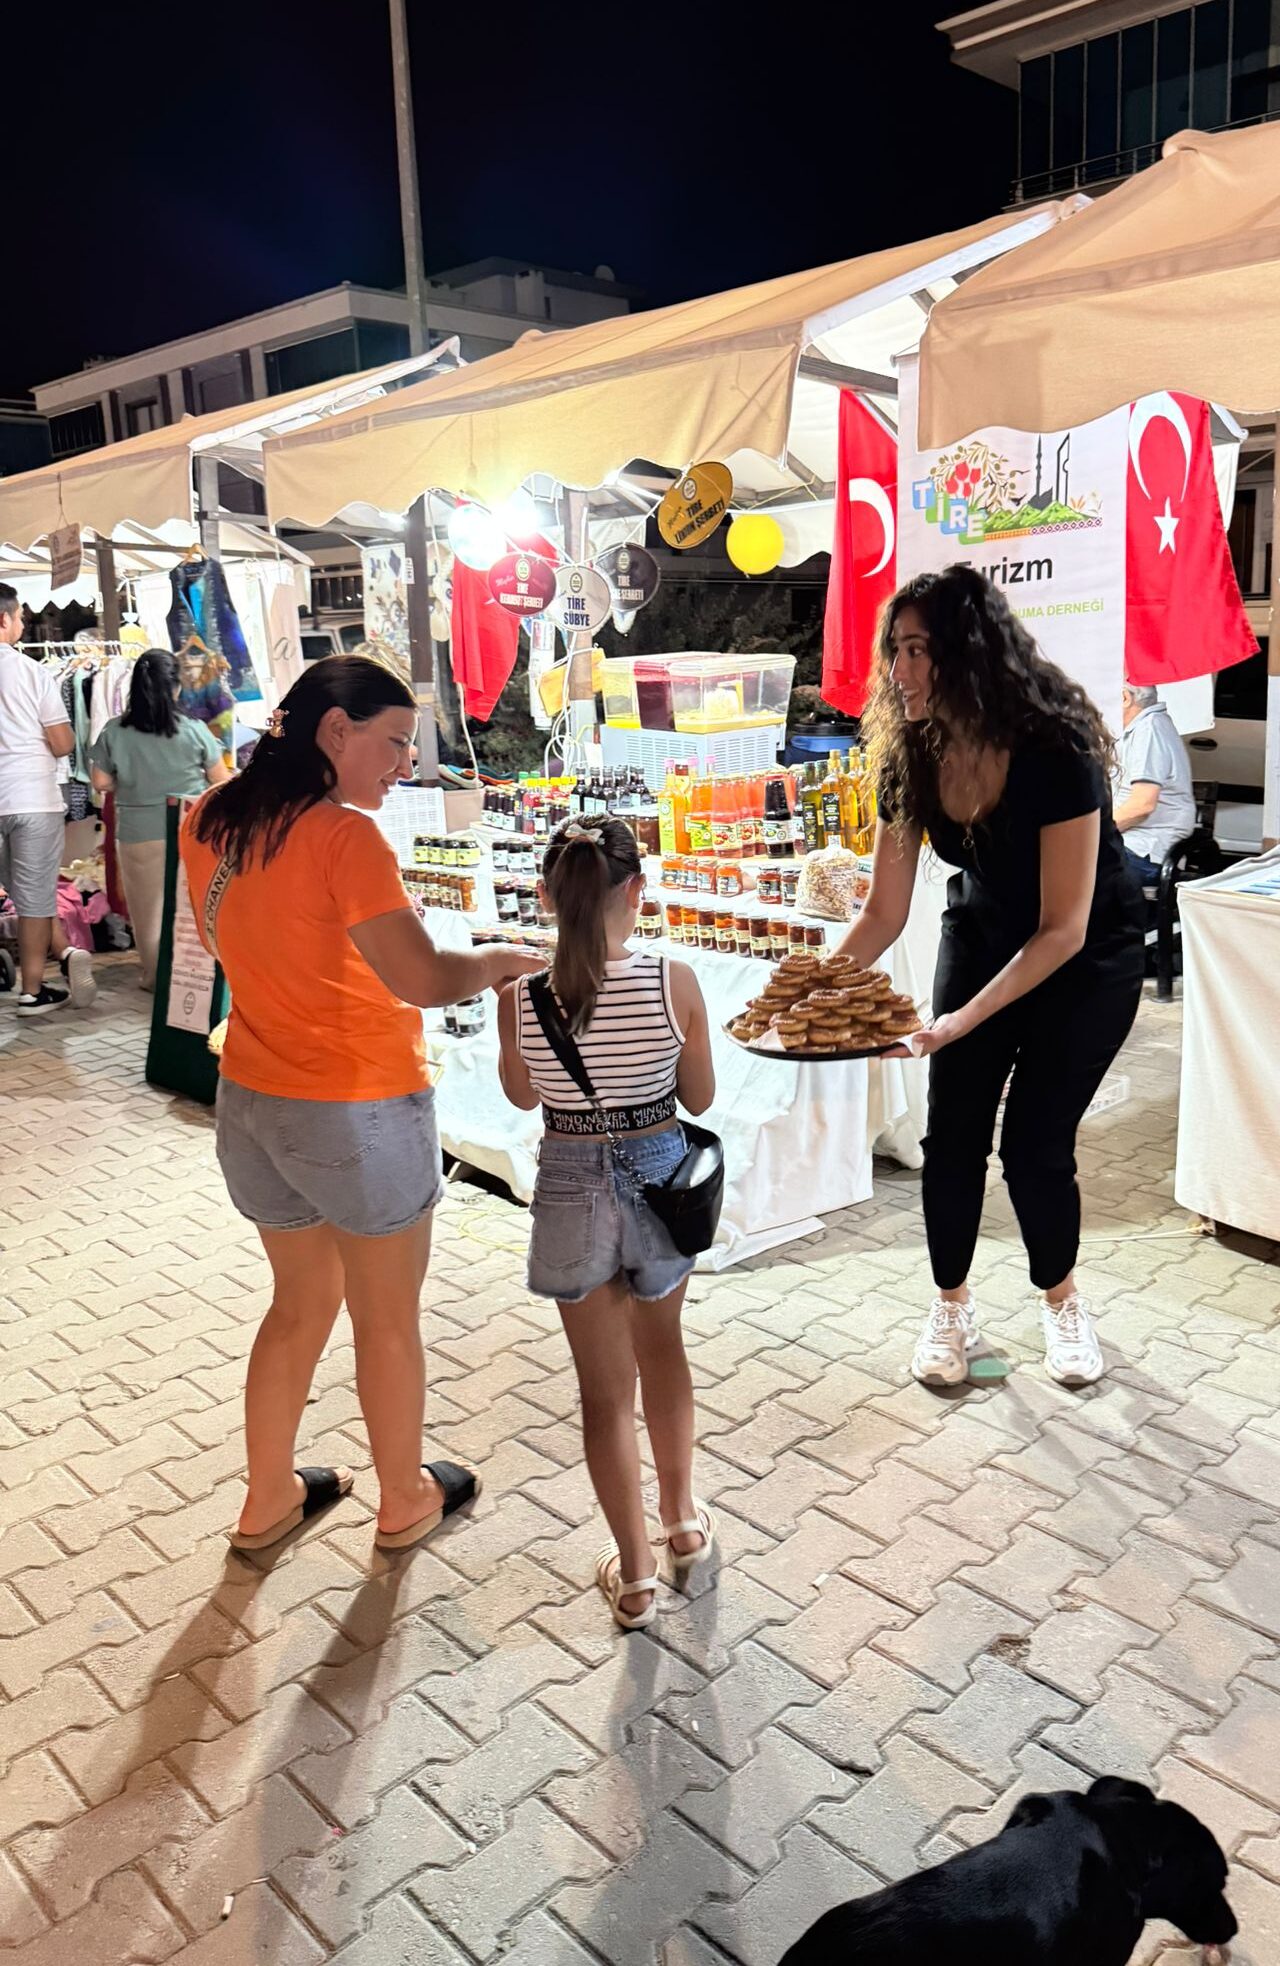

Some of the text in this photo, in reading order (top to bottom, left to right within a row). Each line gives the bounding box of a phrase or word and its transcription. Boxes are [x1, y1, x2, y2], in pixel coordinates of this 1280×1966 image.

[913, 481, 985, 539] TİRE
[955, 557, 1053, 585] rizm
[567, 596, 586, 610] TİRE
[1047, 598, 1104, 616] DERNEĞİ
[564, 612, 590, 627] SÜBYE
[207, 860, 235, 921] CHANEL
[553, 1112, 583, 1127] MIND
[633, 1104, 663, 1119] MIND
[556, 1121, 593, 1133] NEVER
